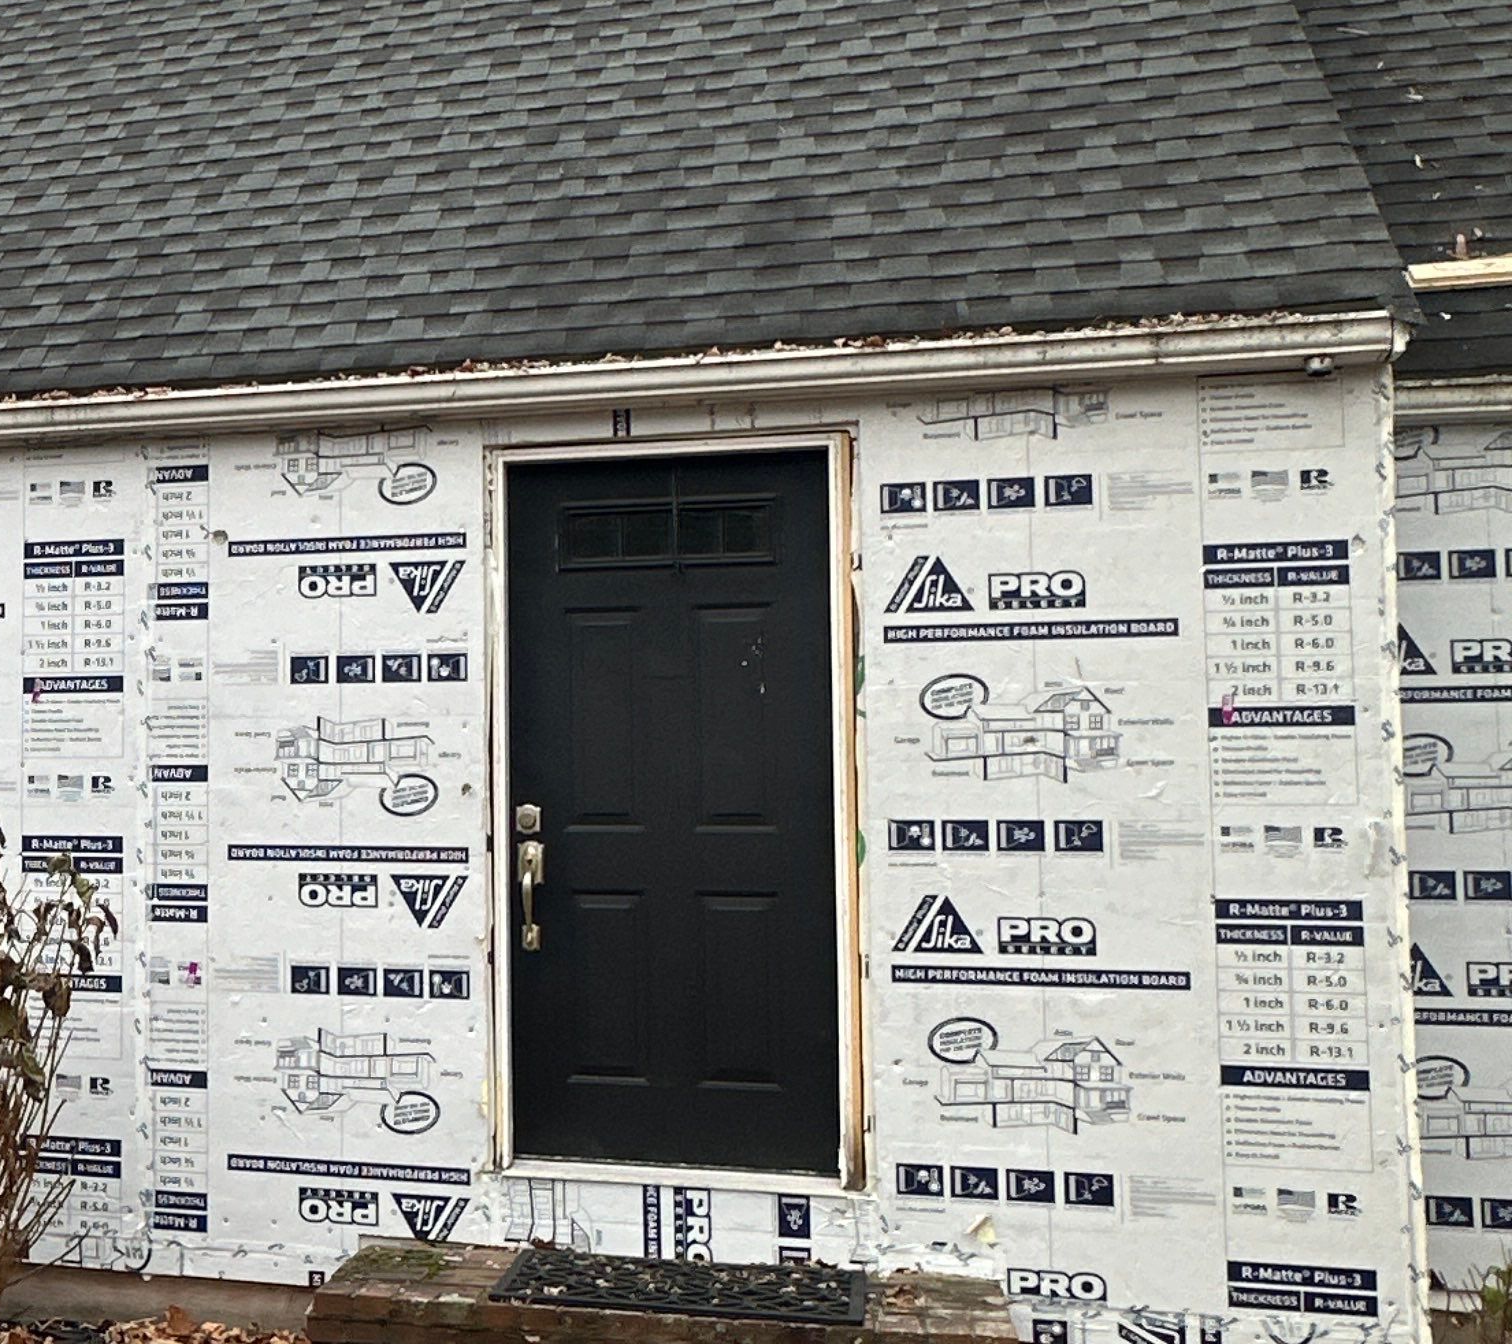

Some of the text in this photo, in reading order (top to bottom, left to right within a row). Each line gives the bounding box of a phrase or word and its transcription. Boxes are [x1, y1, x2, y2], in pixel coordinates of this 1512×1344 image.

[1288, 545, 1333, 557] Plus-3
[398, 565, 441, 597] Sika
[1207, 572, 1271, 584] THICKNESS
[301, 575, 375, 598] PRO
[914, 574, 963, 608] Sika
[991, 572, 1083, 598] PRO
[1240, 594, 1268, 604] inch
[1241, 616, 1270, 627] inch
[1294, 615, 1333, 626] R-5.0
[920, 627, 1010, 639] PERFORMANCE
[1014, 625, 1048, 636] FOAM
[1052, 623, 1127, 636] INSULATION
[1131, 622, 1174, 633] BOARD
[1241, 639, 1270, 650] inch
[1295, 638, 1334, 649] R-6.0
[1242, 662, 1271, 673] inch
[1296, 661, 1334, 672] R-9.6
[1232, 684, 1272, 696] 2 inch
[1232, 710, 1332, 723] ADVANTAGES
[301, 884, 376, 906] PRO
[400, 879, 442, 911] Sika
[1301, 904, 1347, 917] Plus-3
[922, 915, 971, 949] Sika
[1000, 918, 1094, 944] PRO
[1219, 929, 1284, 940] THICKNESS
[1301, 931, 1352, 941] R-VALUE
[1253, 950, 1282, 962] inch
[1306, 952, 1344, 964] R-3.2
[895, 968, 1186, 987] HIGH PERFORMANCE FOAM INSULATION BOARD
[1253, 974, 1282, 986] inch
[1307, 976, 1347, 987] R-5.0
[1254, 998, 1283, 1009] inch
[1308, 999, 1348, 1011] R-6.0
[1255, 1021, 1284, 1032] inch
[1309, 1023, 1349, 1034] R-9.6
[1243, 1044, 1285, 1056] 2 inch
[1310, 1046, 1353, 1058] R-13.1
[1243, 1070, 1346, 1086] ADVANTAGES
[301, 1199, 377, 1225] PRO
[401, 1199, 444, 1231] Sika
[646, 1203, 659, 1241] FOAM
[1314, 1271, 1362, 1286] Plus-3
[1010, 1271, 1105, 1299] PRO
[1315, 1298, 1367, 1312] R-VALUE
